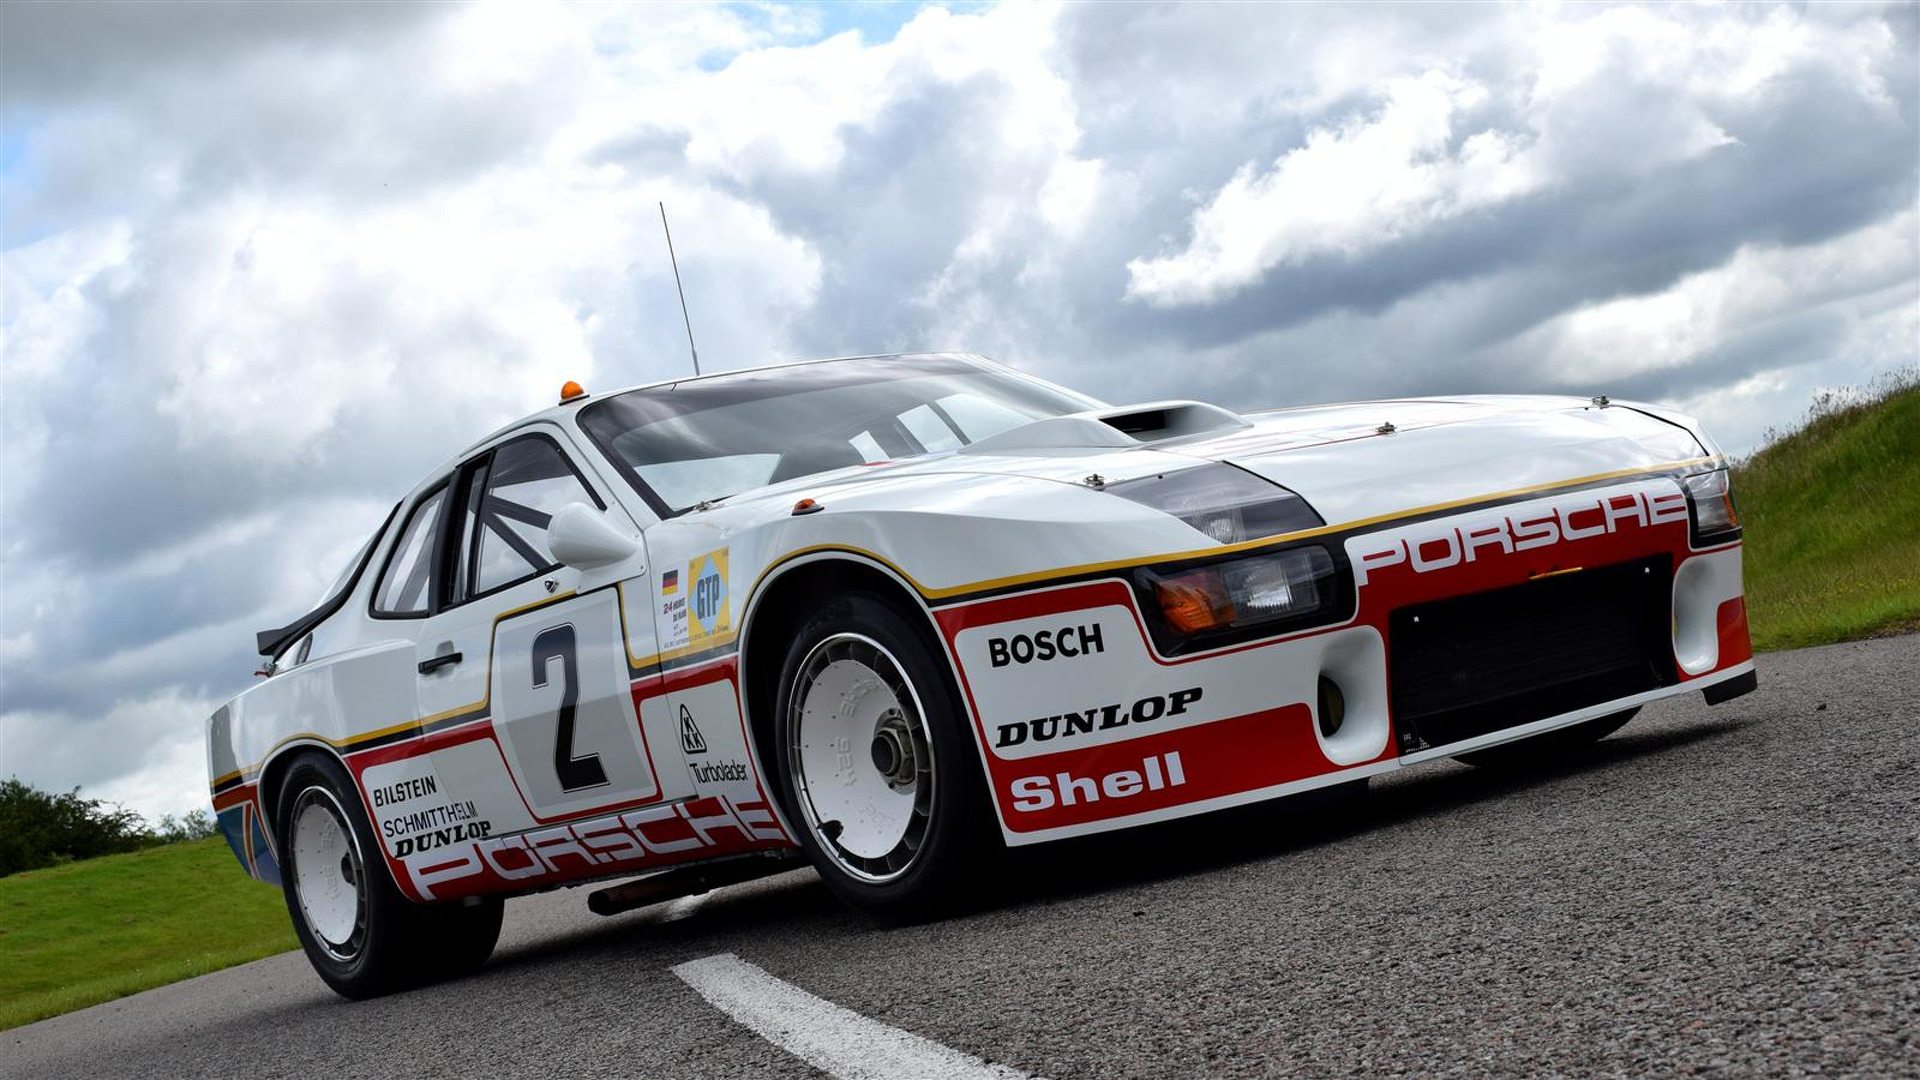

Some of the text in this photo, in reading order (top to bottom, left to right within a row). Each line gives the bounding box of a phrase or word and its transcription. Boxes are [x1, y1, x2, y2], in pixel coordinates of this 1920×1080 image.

[1352, 485, 1688, 586] PORSCHE
[663, 600, 673, 615] 24
[696, 573, 720, 620] GTP
[988, 623, 1105, 668] BOSCH
[530, 621, 611, 794] 2
[995, 687, 1203, 748] DUNLOP
[373, 775, 437, 807] BILSTEIN
[689, 759, 749, 784] Turbolader
[1010, 751, 1186, 812] Shell
[383, 800, 479, 838] SCHMITTHELM
[395, 820, 491, 858] DUNLOP
[403, 793, 788, 900] PORSCHE
